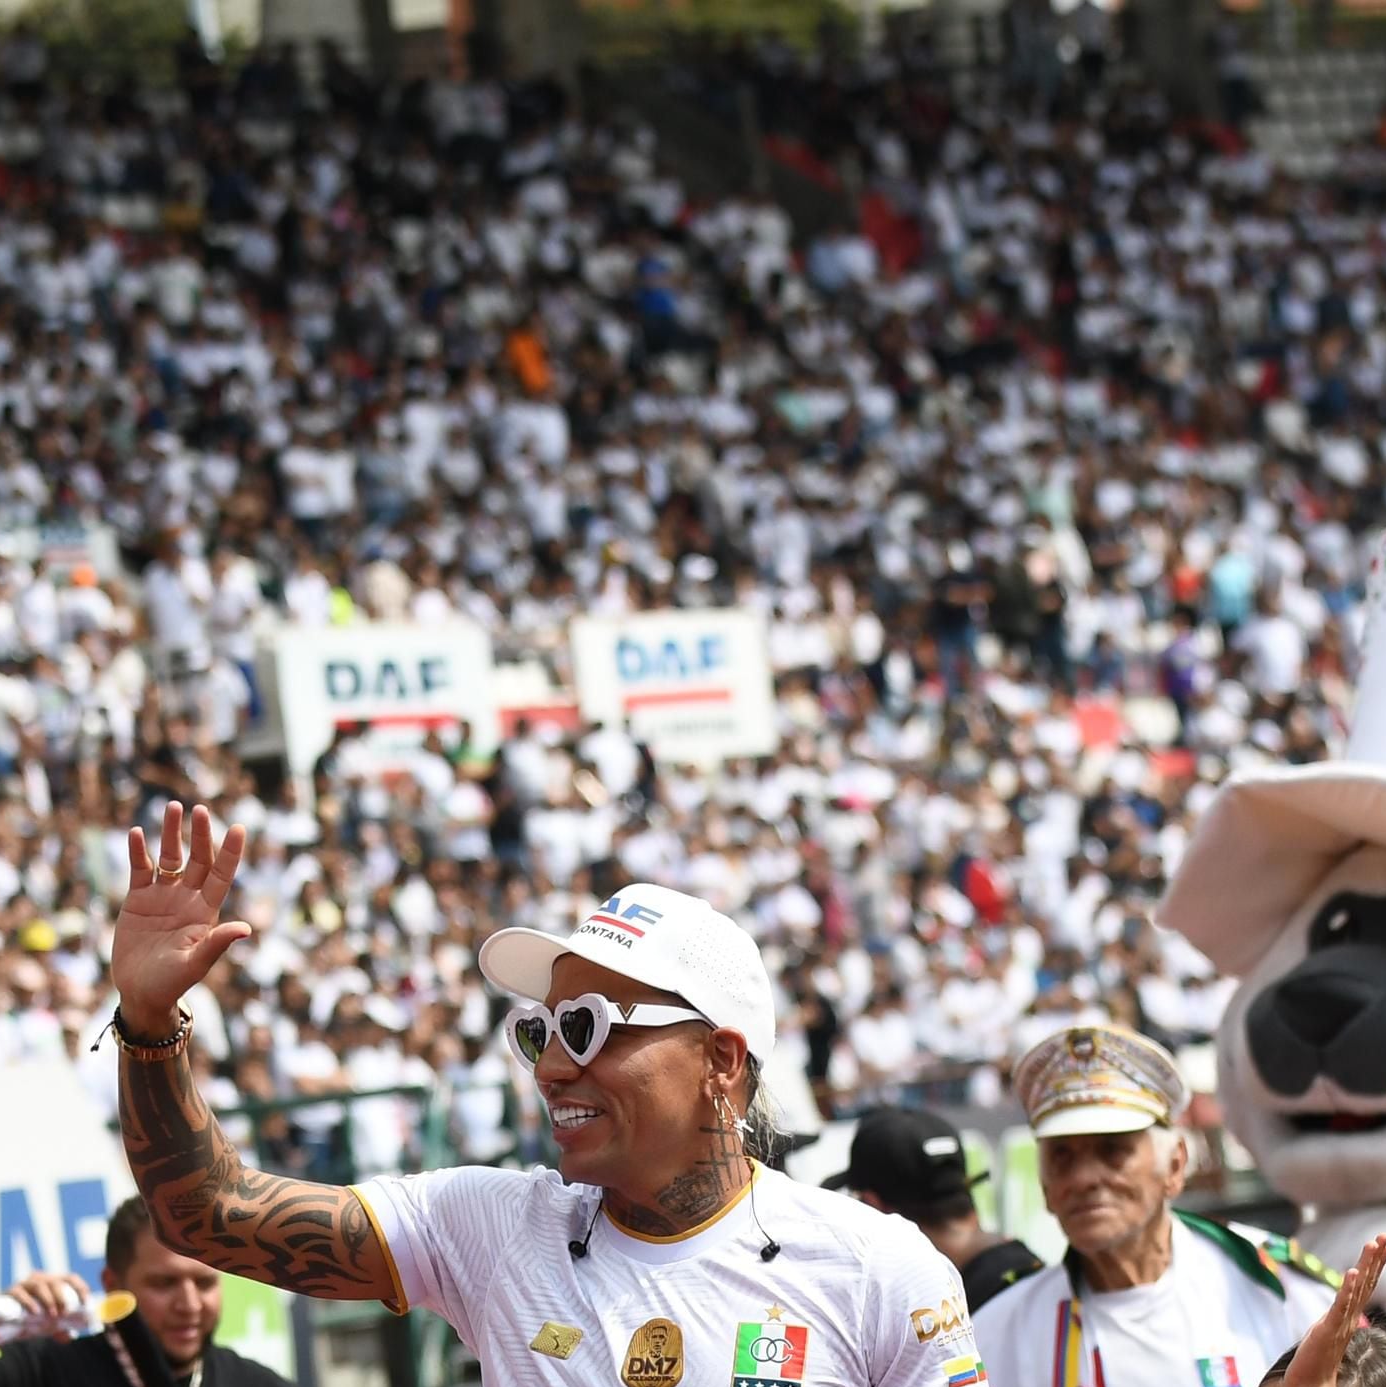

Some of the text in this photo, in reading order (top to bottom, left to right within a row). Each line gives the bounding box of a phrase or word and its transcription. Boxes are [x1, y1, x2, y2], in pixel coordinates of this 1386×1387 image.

[324, 654, 453, 700] DAF
[615, 634, 727, 684] DAF
[597, 896, 664, 926] AF
[574, 924, 634, 950] ONTAÑA
